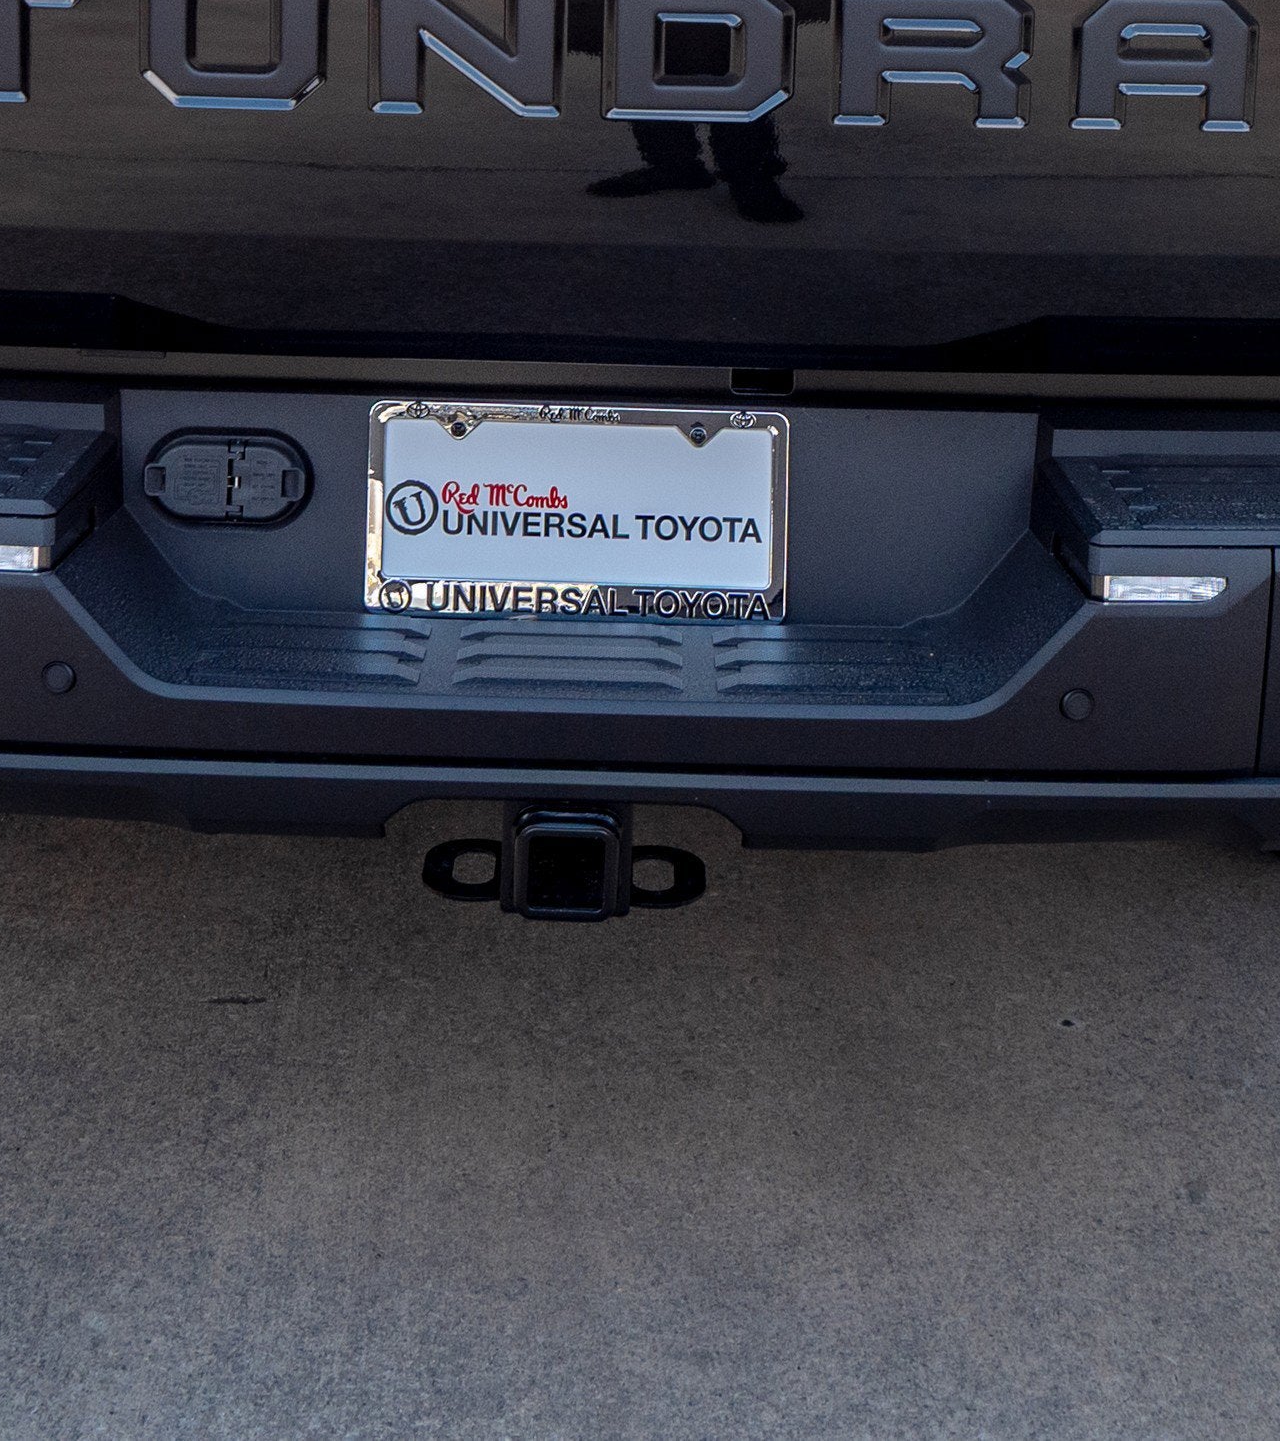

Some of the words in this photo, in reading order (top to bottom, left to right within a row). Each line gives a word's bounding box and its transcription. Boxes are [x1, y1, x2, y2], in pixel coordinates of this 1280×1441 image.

[441, 480, 480, 515] Red
[483, 483, 568, 509] McCombs
[441, 509, 630, 540] UNIVERSAL
[634, 514, 763, 544] TOYOTA
[425, 580, 630, 617] UNIVERSAL
[631, 588, 771, 621] TOYOTA
